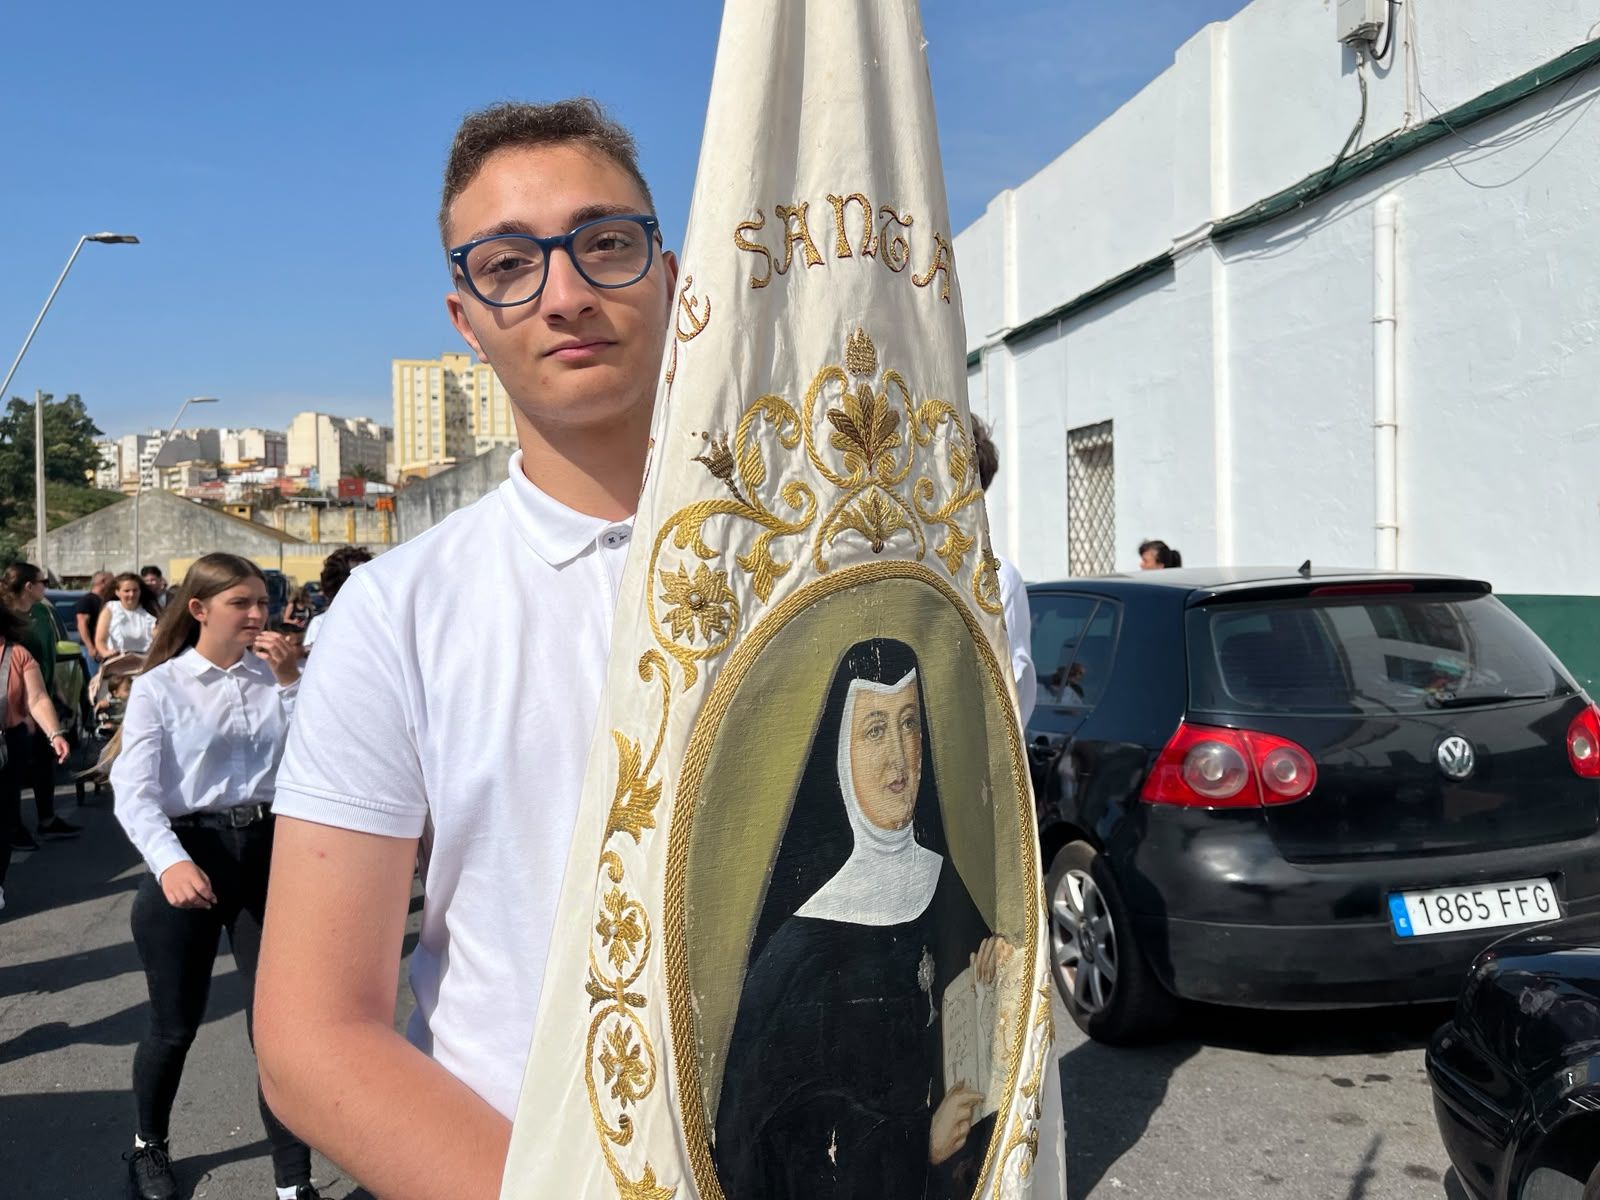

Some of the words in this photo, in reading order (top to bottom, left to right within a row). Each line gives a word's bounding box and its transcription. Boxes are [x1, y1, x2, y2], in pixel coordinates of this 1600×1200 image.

[734, 192, 952, 304] SANTA
[1437, 736, 1475, 778] VW
[1418, 891, 1491, 926] 1865
[1496, 884, 1551, 918] FFG
